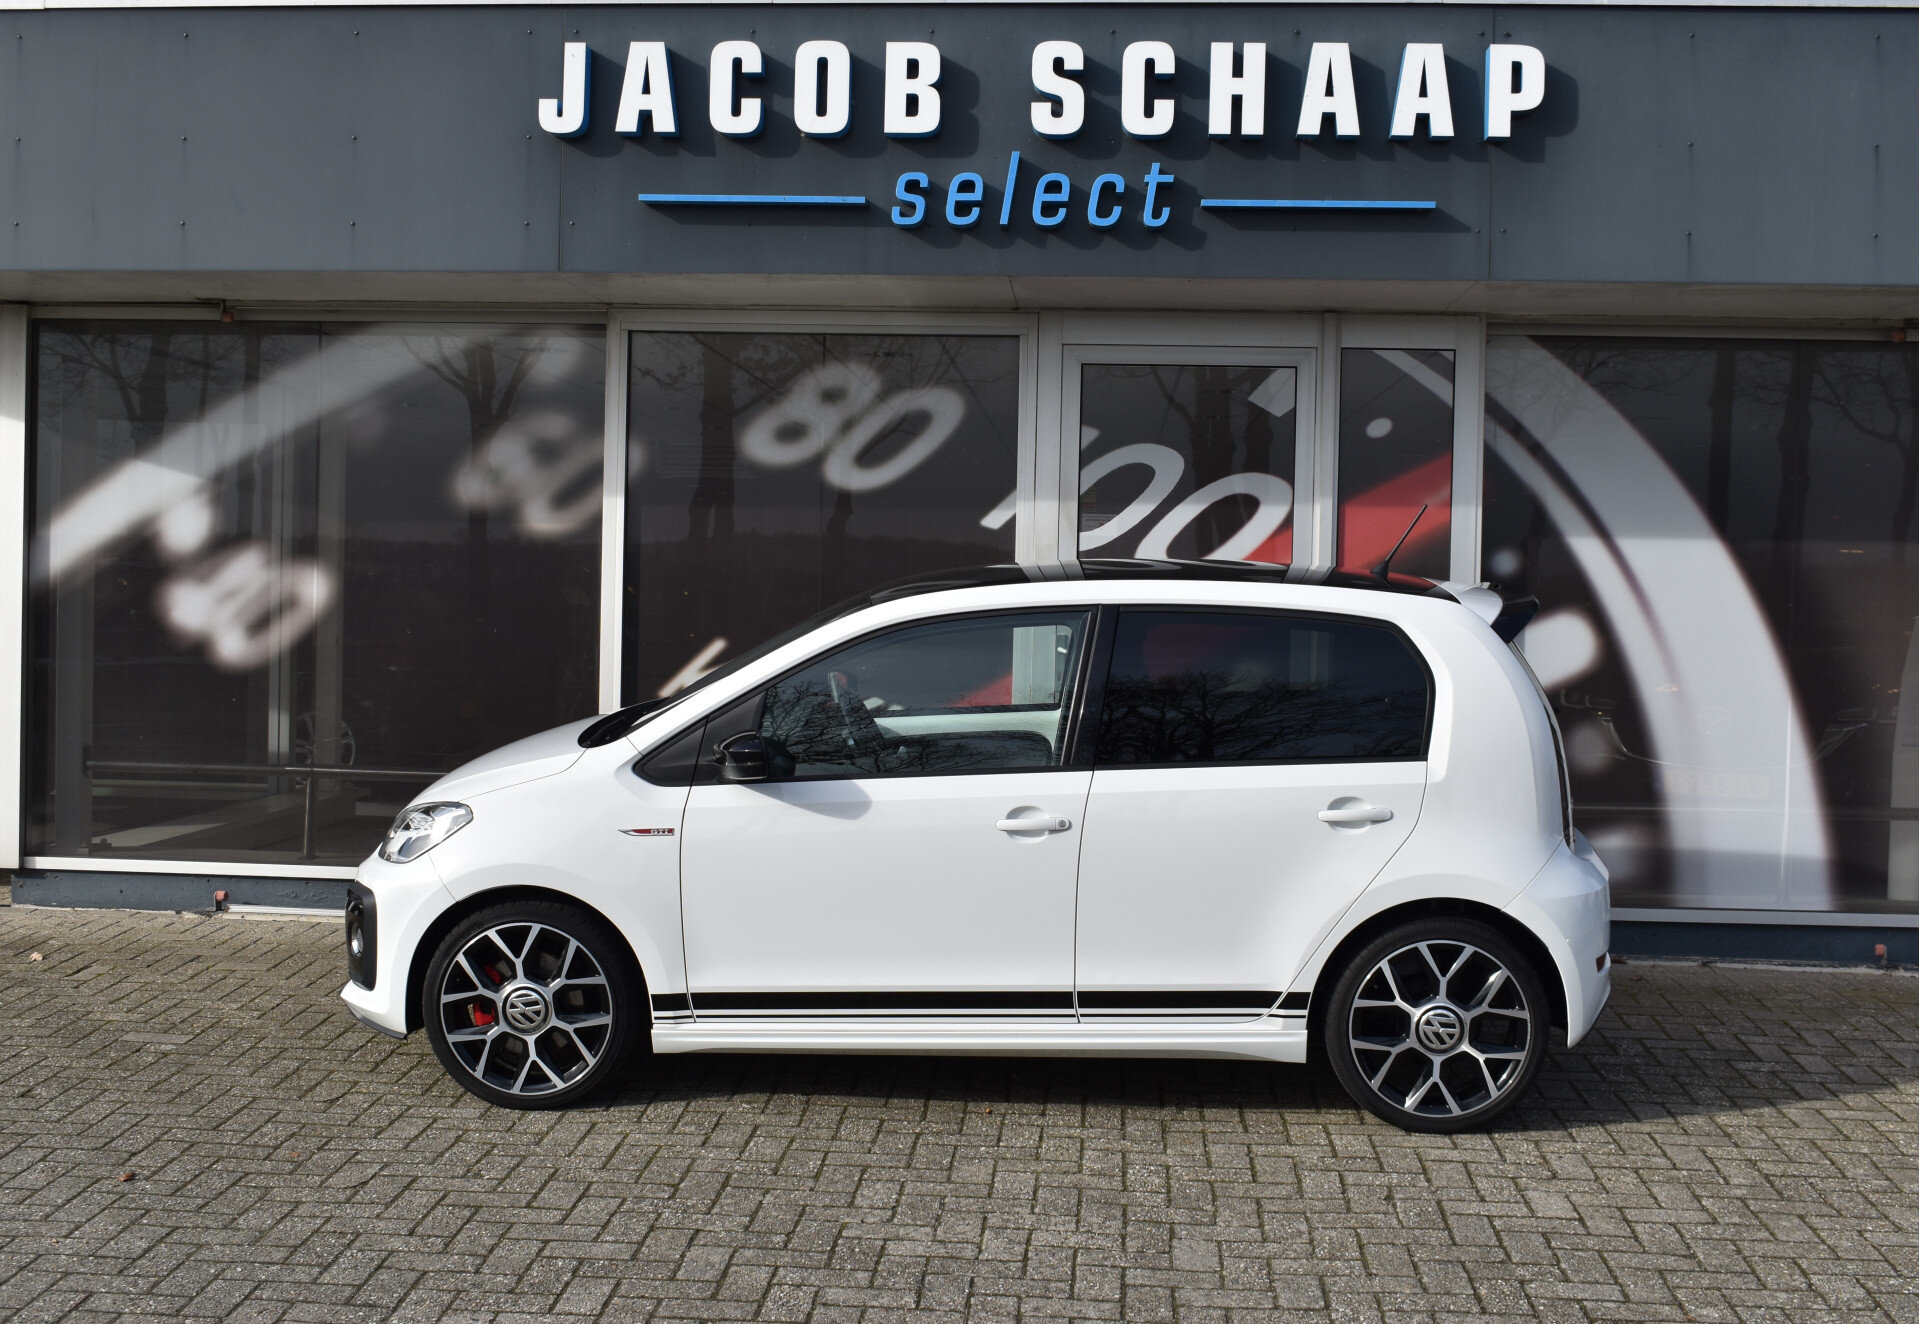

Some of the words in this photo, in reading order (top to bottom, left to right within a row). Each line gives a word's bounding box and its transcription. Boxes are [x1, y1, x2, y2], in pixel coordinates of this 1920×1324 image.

[538, 39, 943, 138] JACOB
[1030, 39, 1546, 141] SCHAAP
[890, 150, 1175, 231] select
[740, 360, 966, 493] 80
